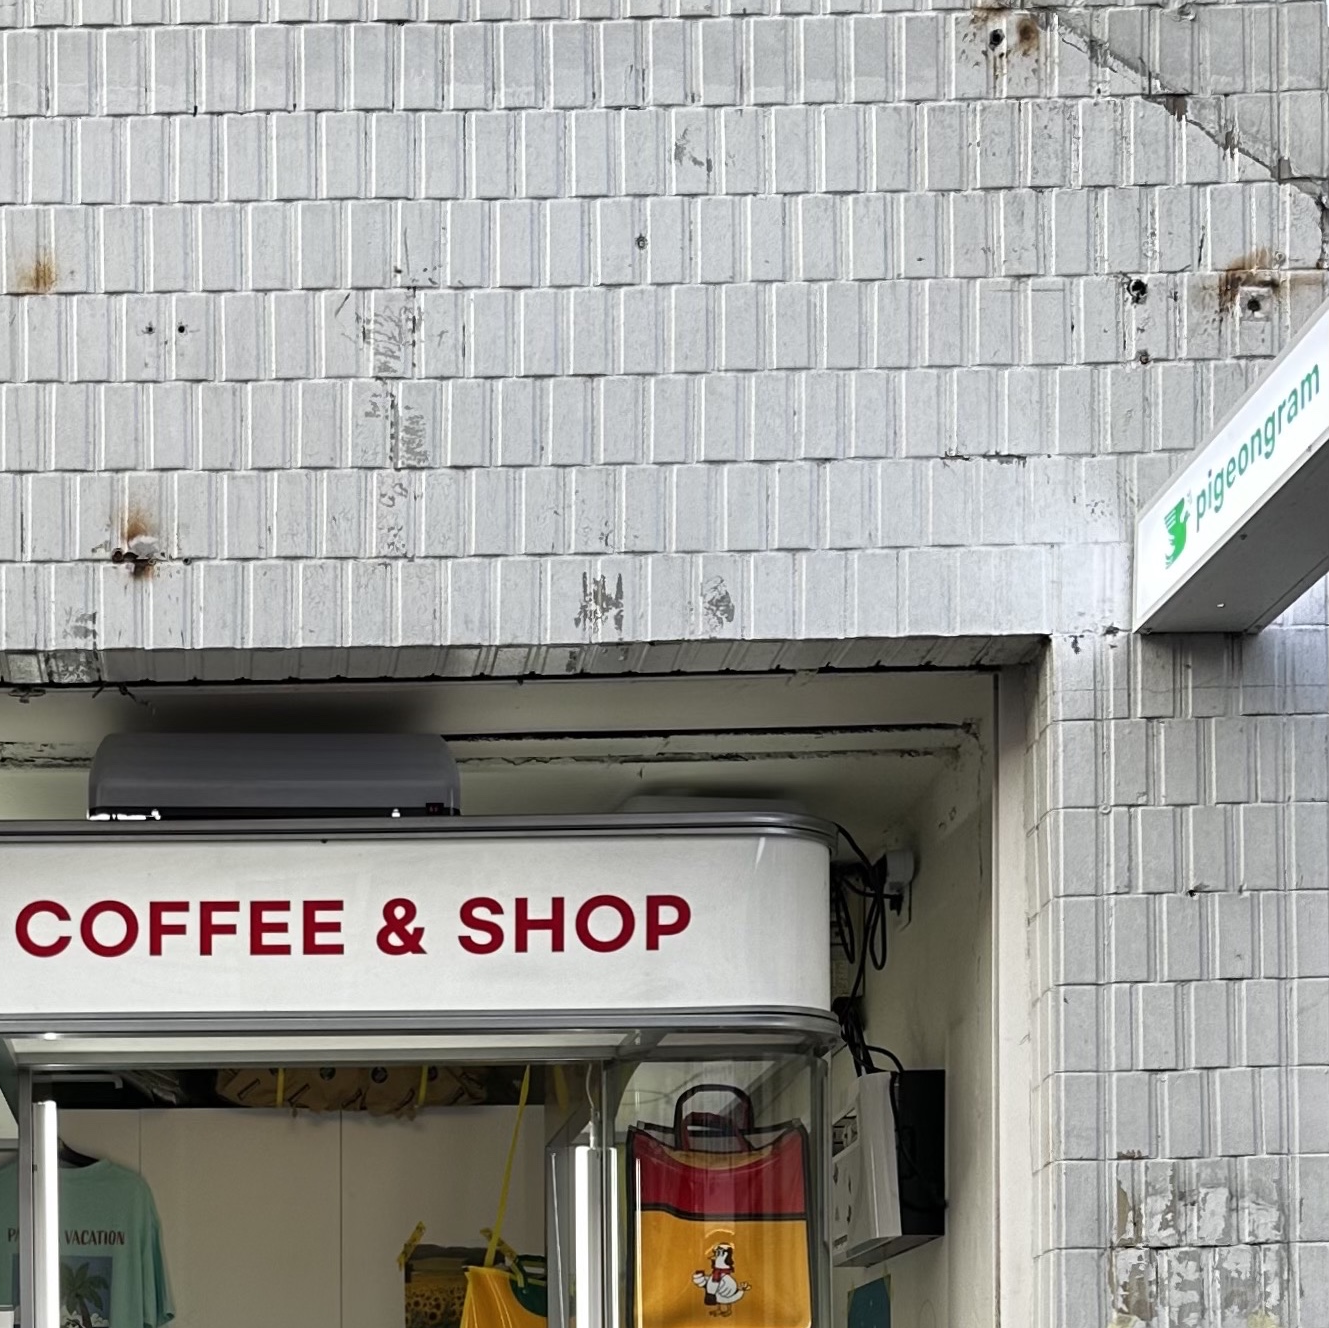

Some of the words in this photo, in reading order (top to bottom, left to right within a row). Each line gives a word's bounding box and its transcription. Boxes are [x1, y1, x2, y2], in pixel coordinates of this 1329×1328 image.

[1195, 364, 1320, 532] pigeongram
[14, 897, 345, 959] COFFEE
[375, 893, 428, 957] &
[457, 893, 692, 955] SHOP
[64, 1229, 125, 1246] VACATION
